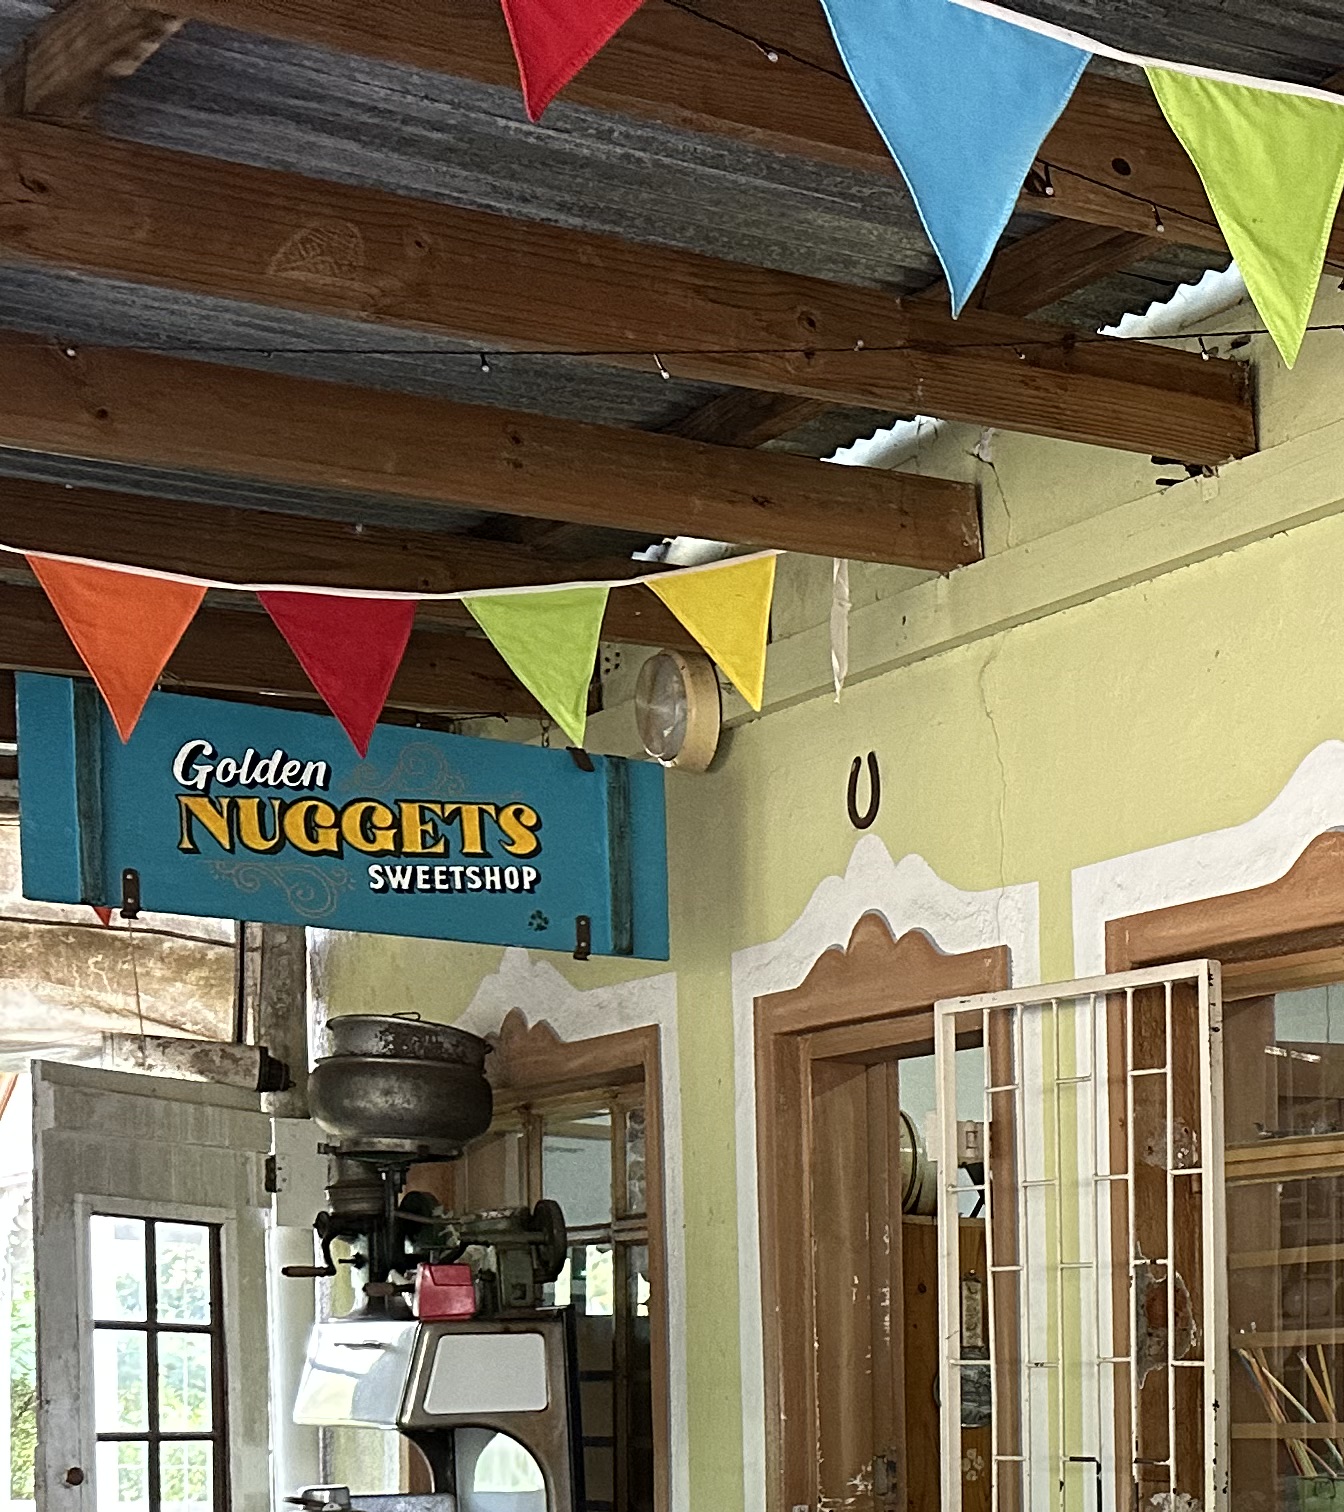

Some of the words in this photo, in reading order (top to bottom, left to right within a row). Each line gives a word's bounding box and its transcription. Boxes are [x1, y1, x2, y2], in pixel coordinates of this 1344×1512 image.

[172, 738, 330, 790] Golden
[178, 795, 543, 858] NUGGETS
[368, 862, 540, 893] SWEETSHOP
